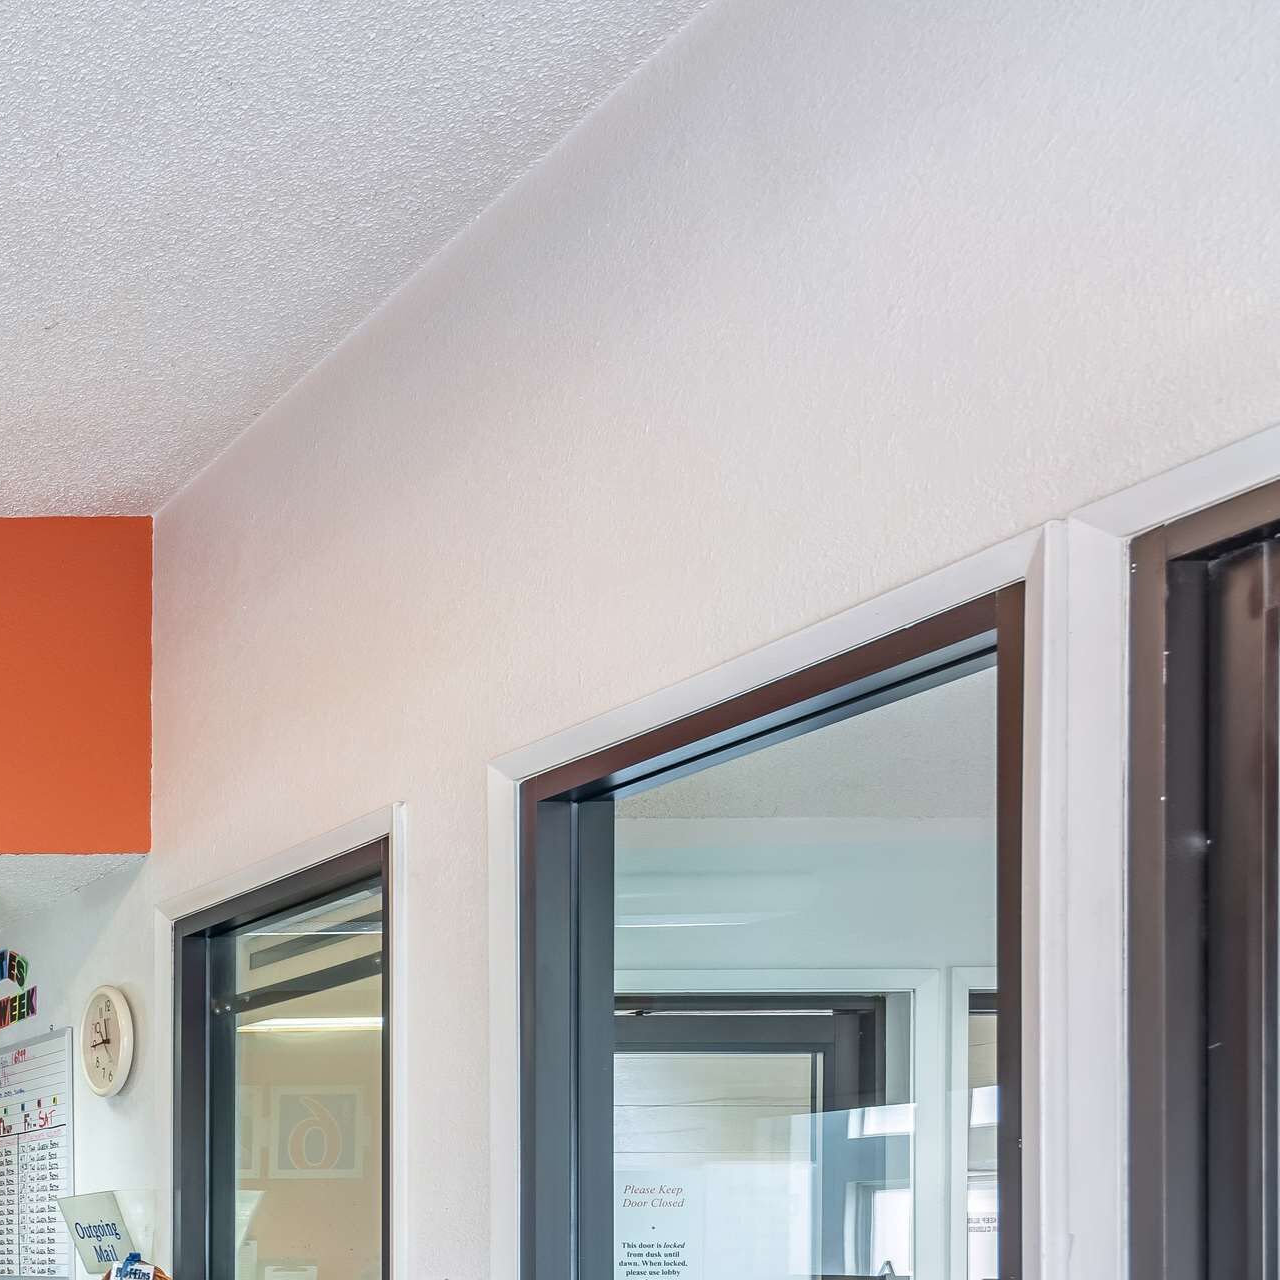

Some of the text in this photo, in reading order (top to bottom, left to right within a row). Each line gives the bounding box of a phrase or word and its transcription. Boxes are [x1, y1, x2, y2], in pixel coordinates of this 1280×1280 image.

[105, 1000, 111, 1012] 12
[623, 1184, 683, 1196] Please Keep
[622, 1198, 685, 1208] Door Closed
[75, 1220, 121, 1241] Outgoing
[94, 1245, 119, 1263] Mail
[625, 1269, 647, 1277] please
[661, 1269, 681, 1277] lobby
